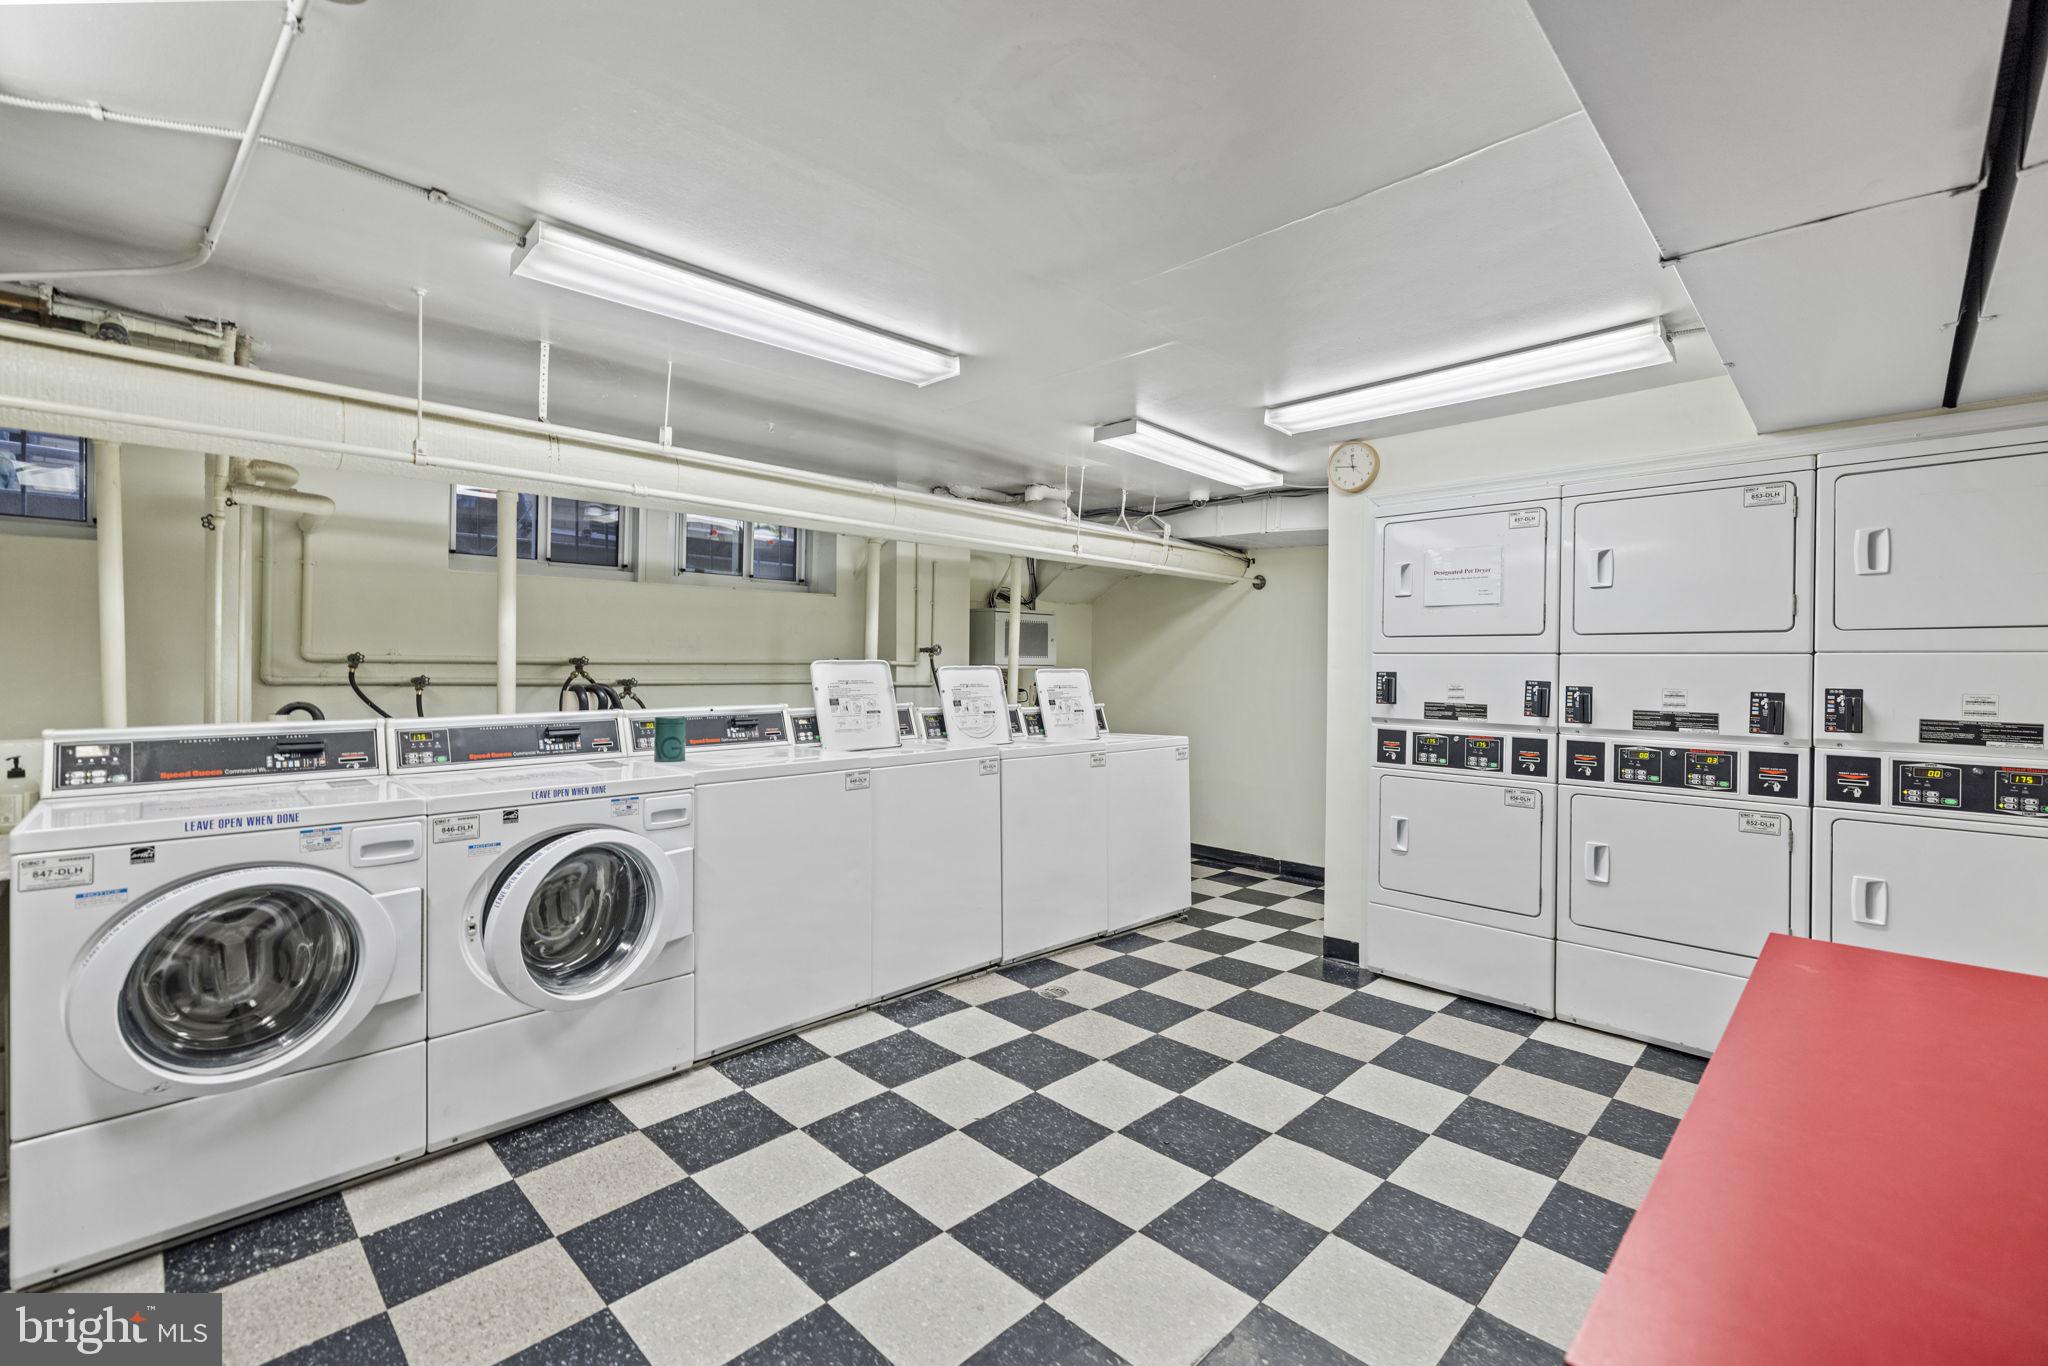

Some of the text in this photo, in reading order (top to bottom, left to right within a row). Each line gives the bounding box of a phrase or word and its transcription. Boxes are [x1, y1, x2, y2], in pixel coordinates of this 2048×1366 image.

[468, 752, 491, 760] Speed
[160, 772, 191, 780] Speed
[192, 768, 222, 777] Queen
[2015, 776, 2033, 784] 175
[532, 785, 606, 800] LEAVE OPEN WHEN DONE
[184, 812, 300, 832] LEAVE OPEN WHEN DONE
[442, 824, 474, 834] 846-DLH
[32, 866, 83, 878] 847-DLH
